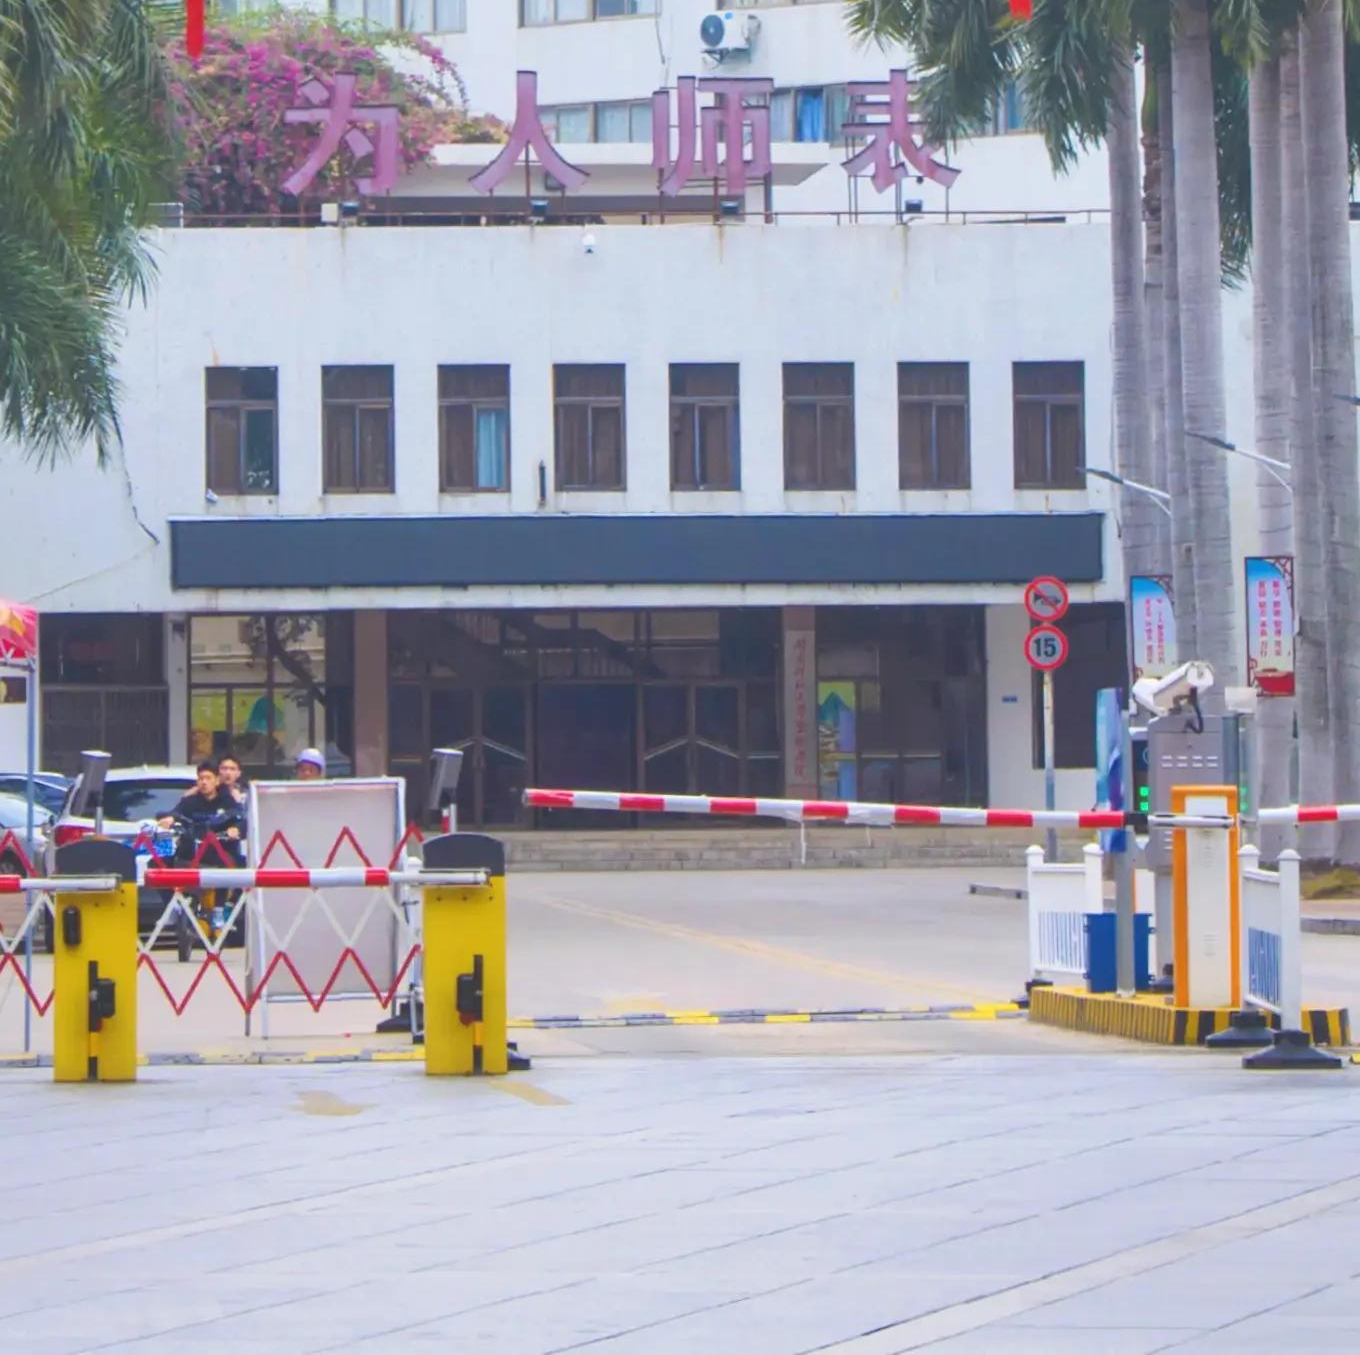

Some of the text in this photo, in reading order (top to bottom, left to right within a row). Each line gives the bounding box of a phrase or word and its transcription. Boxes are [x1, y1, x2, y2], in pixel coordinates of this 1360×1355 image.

[280, 68, 963, 198] 为人师表
[1034, 637, 1057, 657] 15
